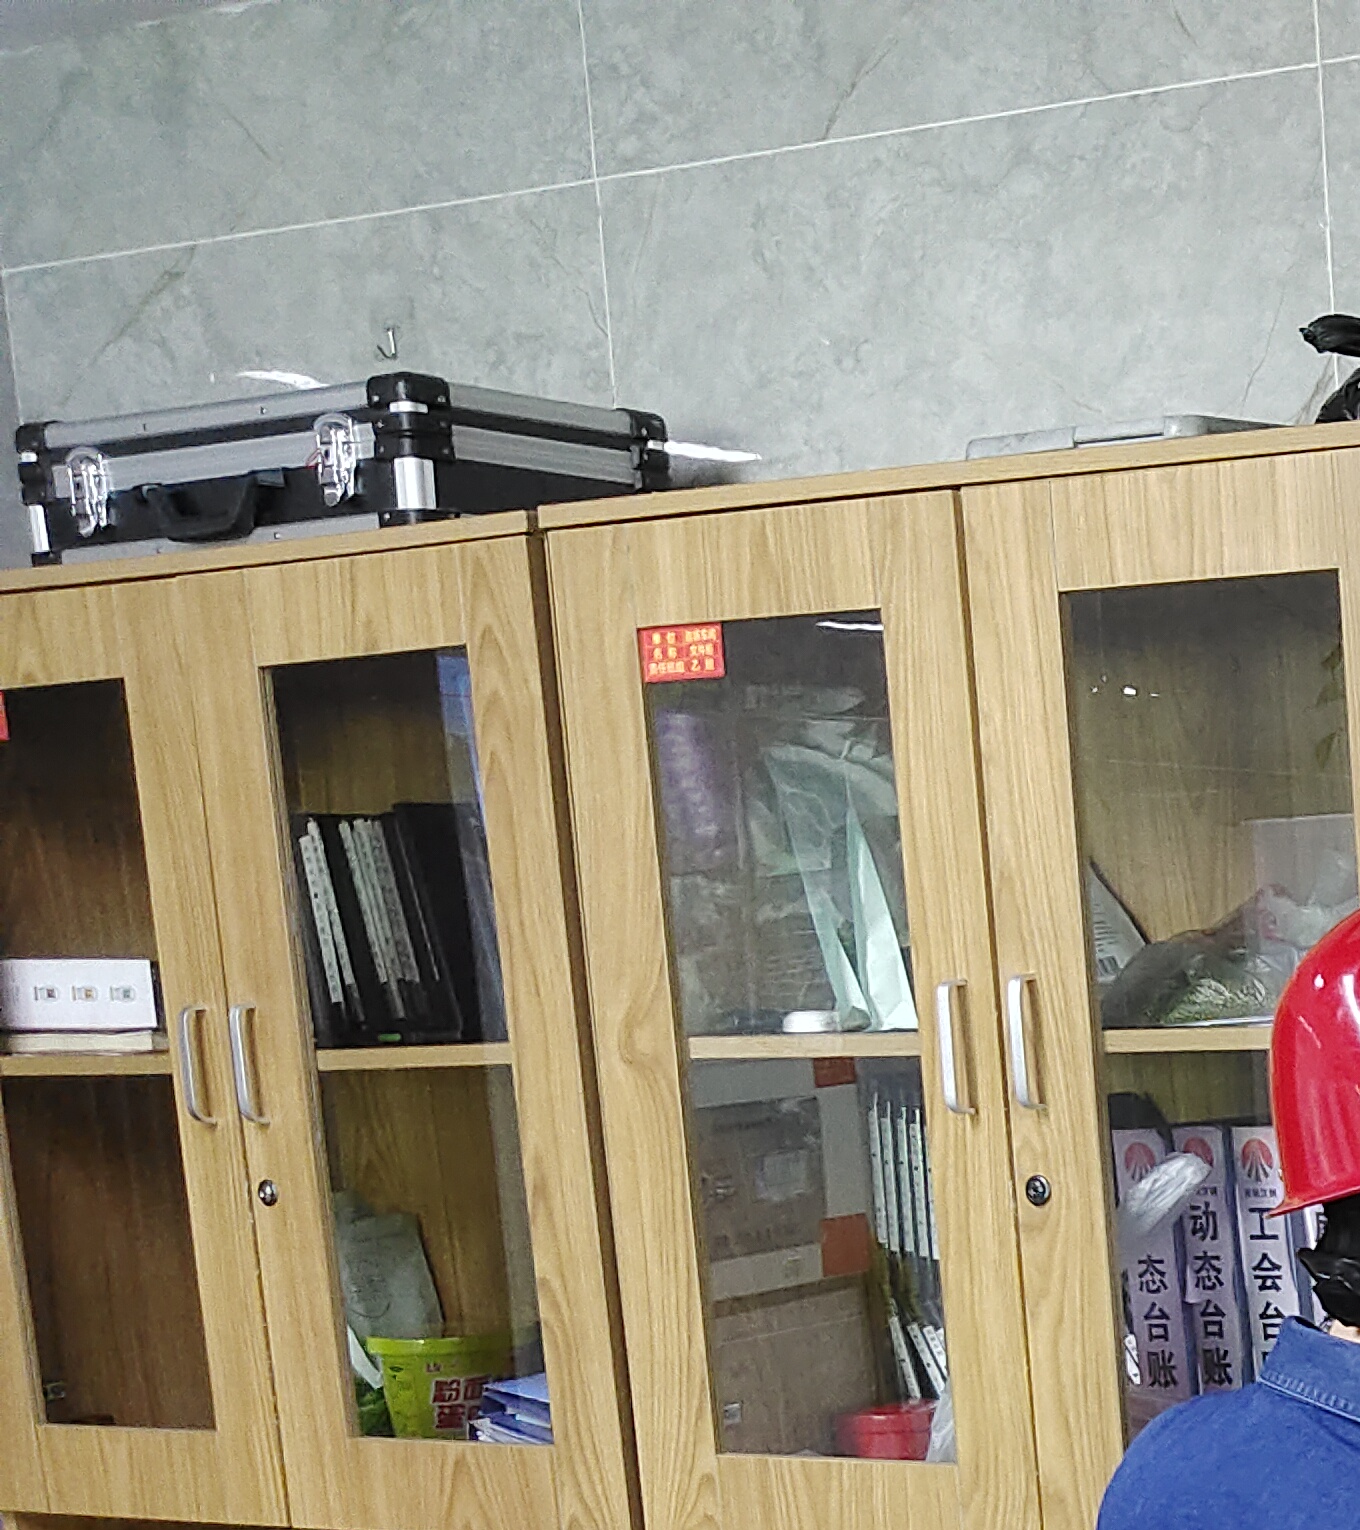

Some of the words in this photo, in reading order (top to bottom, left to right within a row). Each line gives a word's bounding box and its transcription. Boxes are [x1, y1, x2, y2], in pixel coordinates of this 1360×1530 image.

[1189, 1201, 1234, 1386] 动态台账
[1247, 1207, 1286, 1362] 工会台
